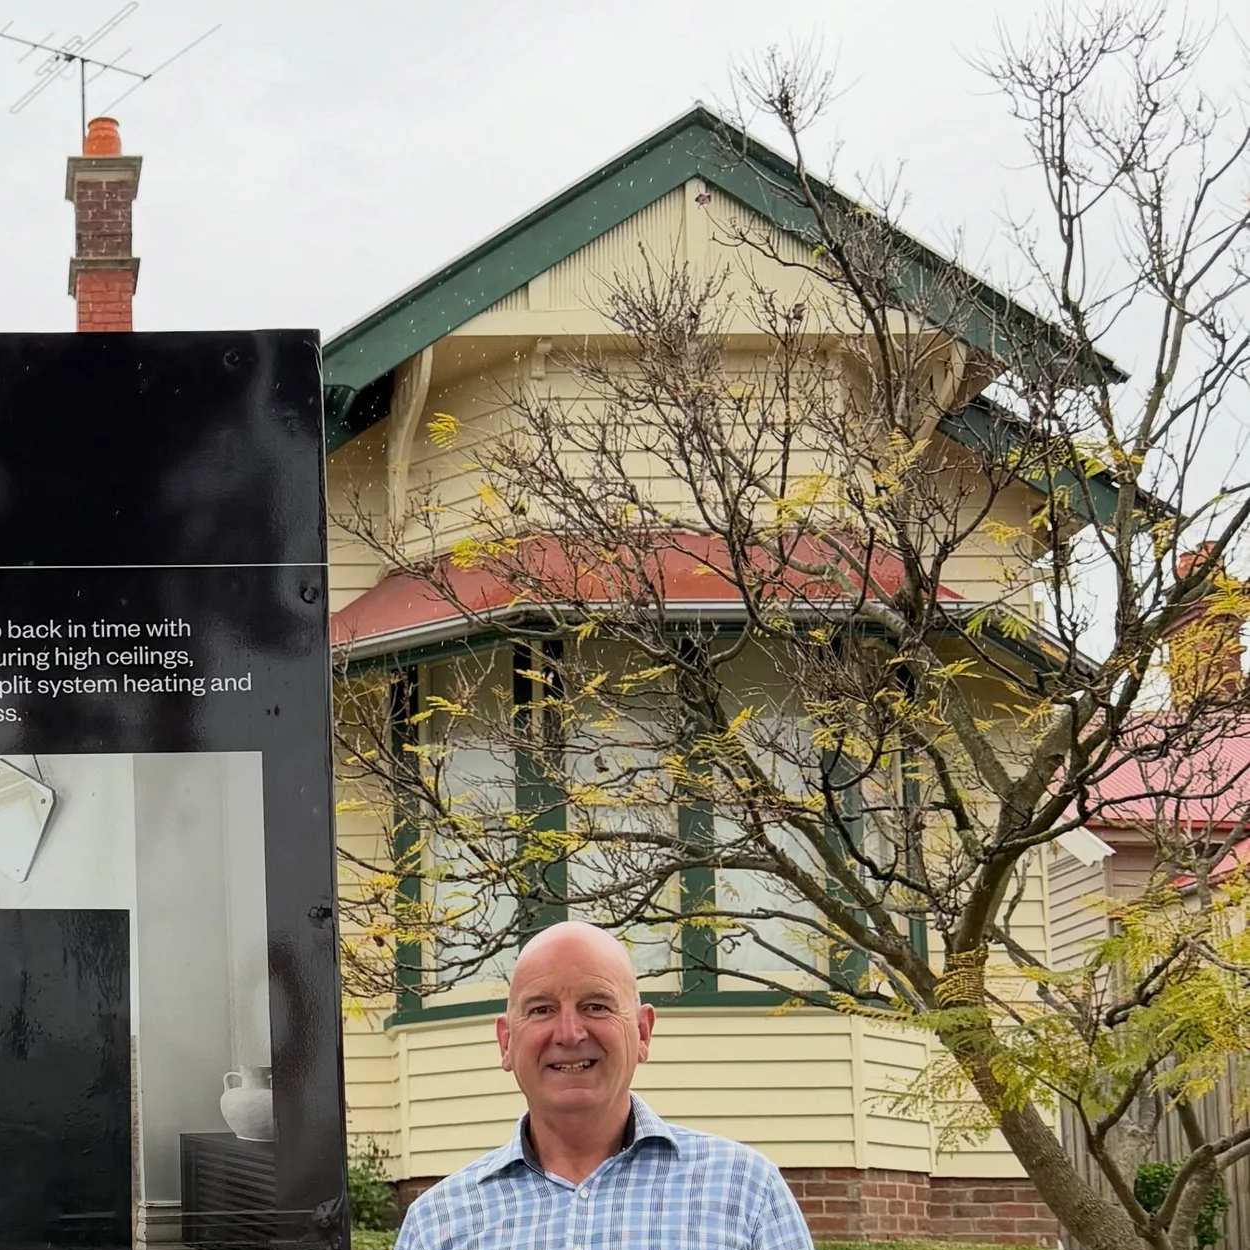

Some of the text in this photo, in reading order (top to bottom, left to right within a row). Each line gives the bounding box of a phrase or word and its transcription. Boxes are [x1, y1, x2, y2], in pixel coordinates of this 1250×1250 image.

[7, 618, 63, 639] back
[67, 618, 87, 639] in
[90, 618, 141, 638] time
[145, 617, 191, 638] with
[54, 646, 101, 671] high
[105, 645, 194, 672] ceilings,
[36, 675, 118, 699] system
[123, 672, 207, 697] heating
[210, 671, 252, 692] and
